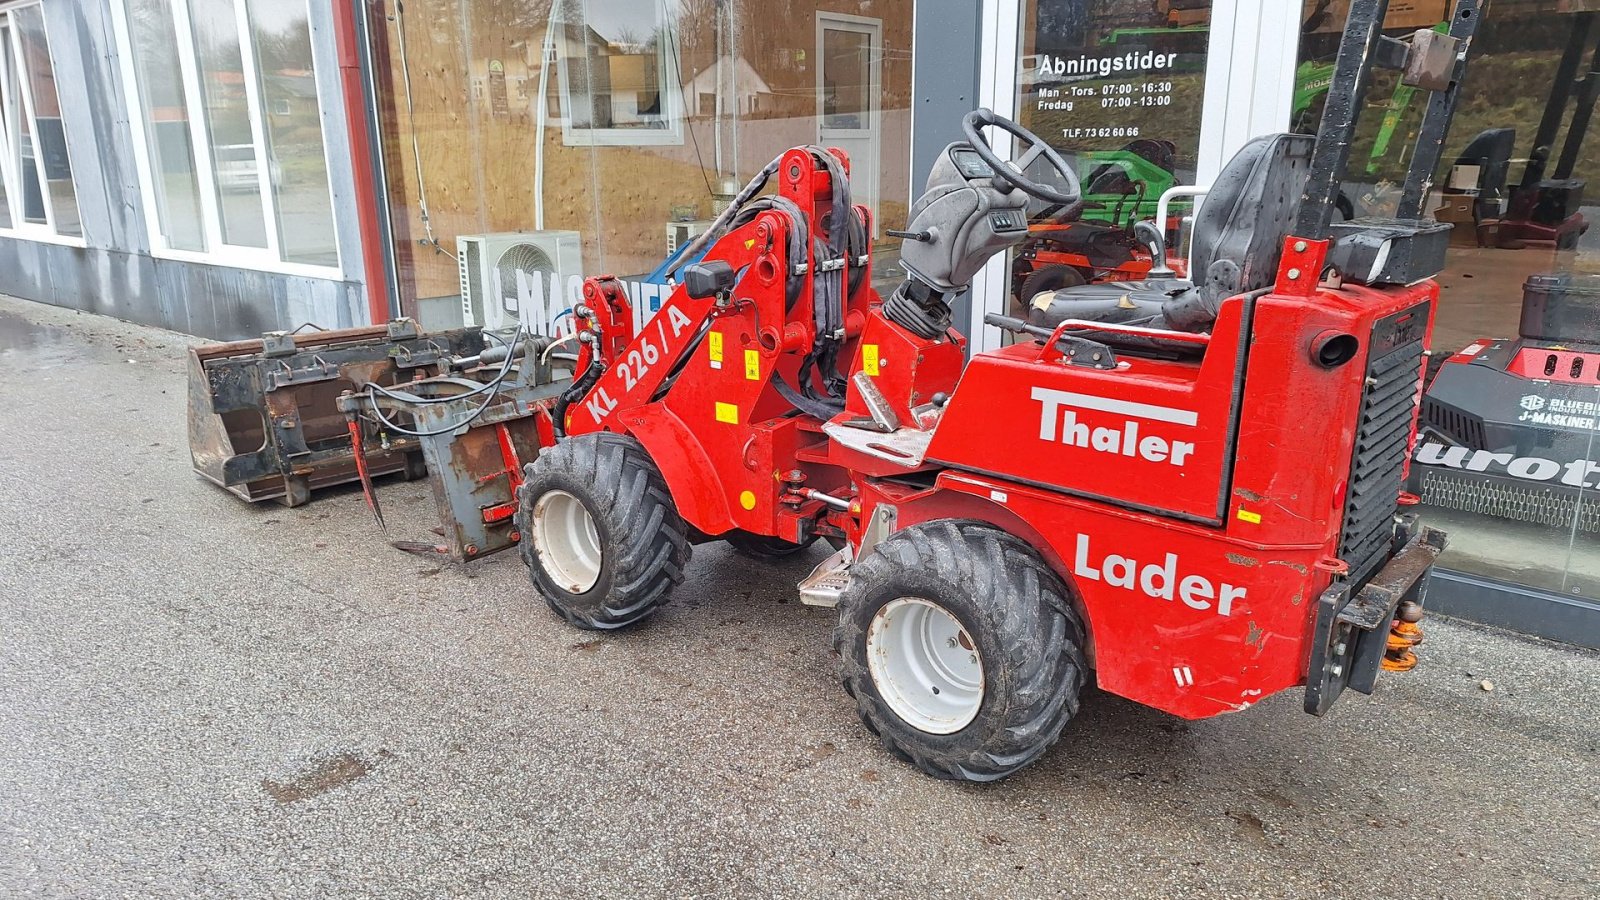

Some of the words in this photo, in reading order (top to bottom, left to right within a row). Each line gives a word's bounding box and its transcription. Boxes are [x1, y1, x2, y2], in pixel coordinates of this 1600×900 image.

[1039, 51, 1177, 76] Åbningstider
[1038, 87, 1060, 98] Man
[1071, 86, 1097, 97] Tors.
[1102, 84, 1132, 95] 07:00
[1141, 82, 1172, 93] 16:30
[1038, 100, 1073, 111] Fredag
[1101, 97, 1131, 108] 07:00
[1140, 95, 1171, 106] 13:00
[1062, 128, 1082, 138] TLF.
[1085, 128, 1097, 138] 73
[1099, 127, 1112, 137] 62
[1112, 127, 1124, 137] 60
[1126, 126, 1139, 137] 66
[585, 387, 618, 424] KL
[1030, 386, 1198, 466] Thaler
[1074, 532, 1247, 617] Lader
